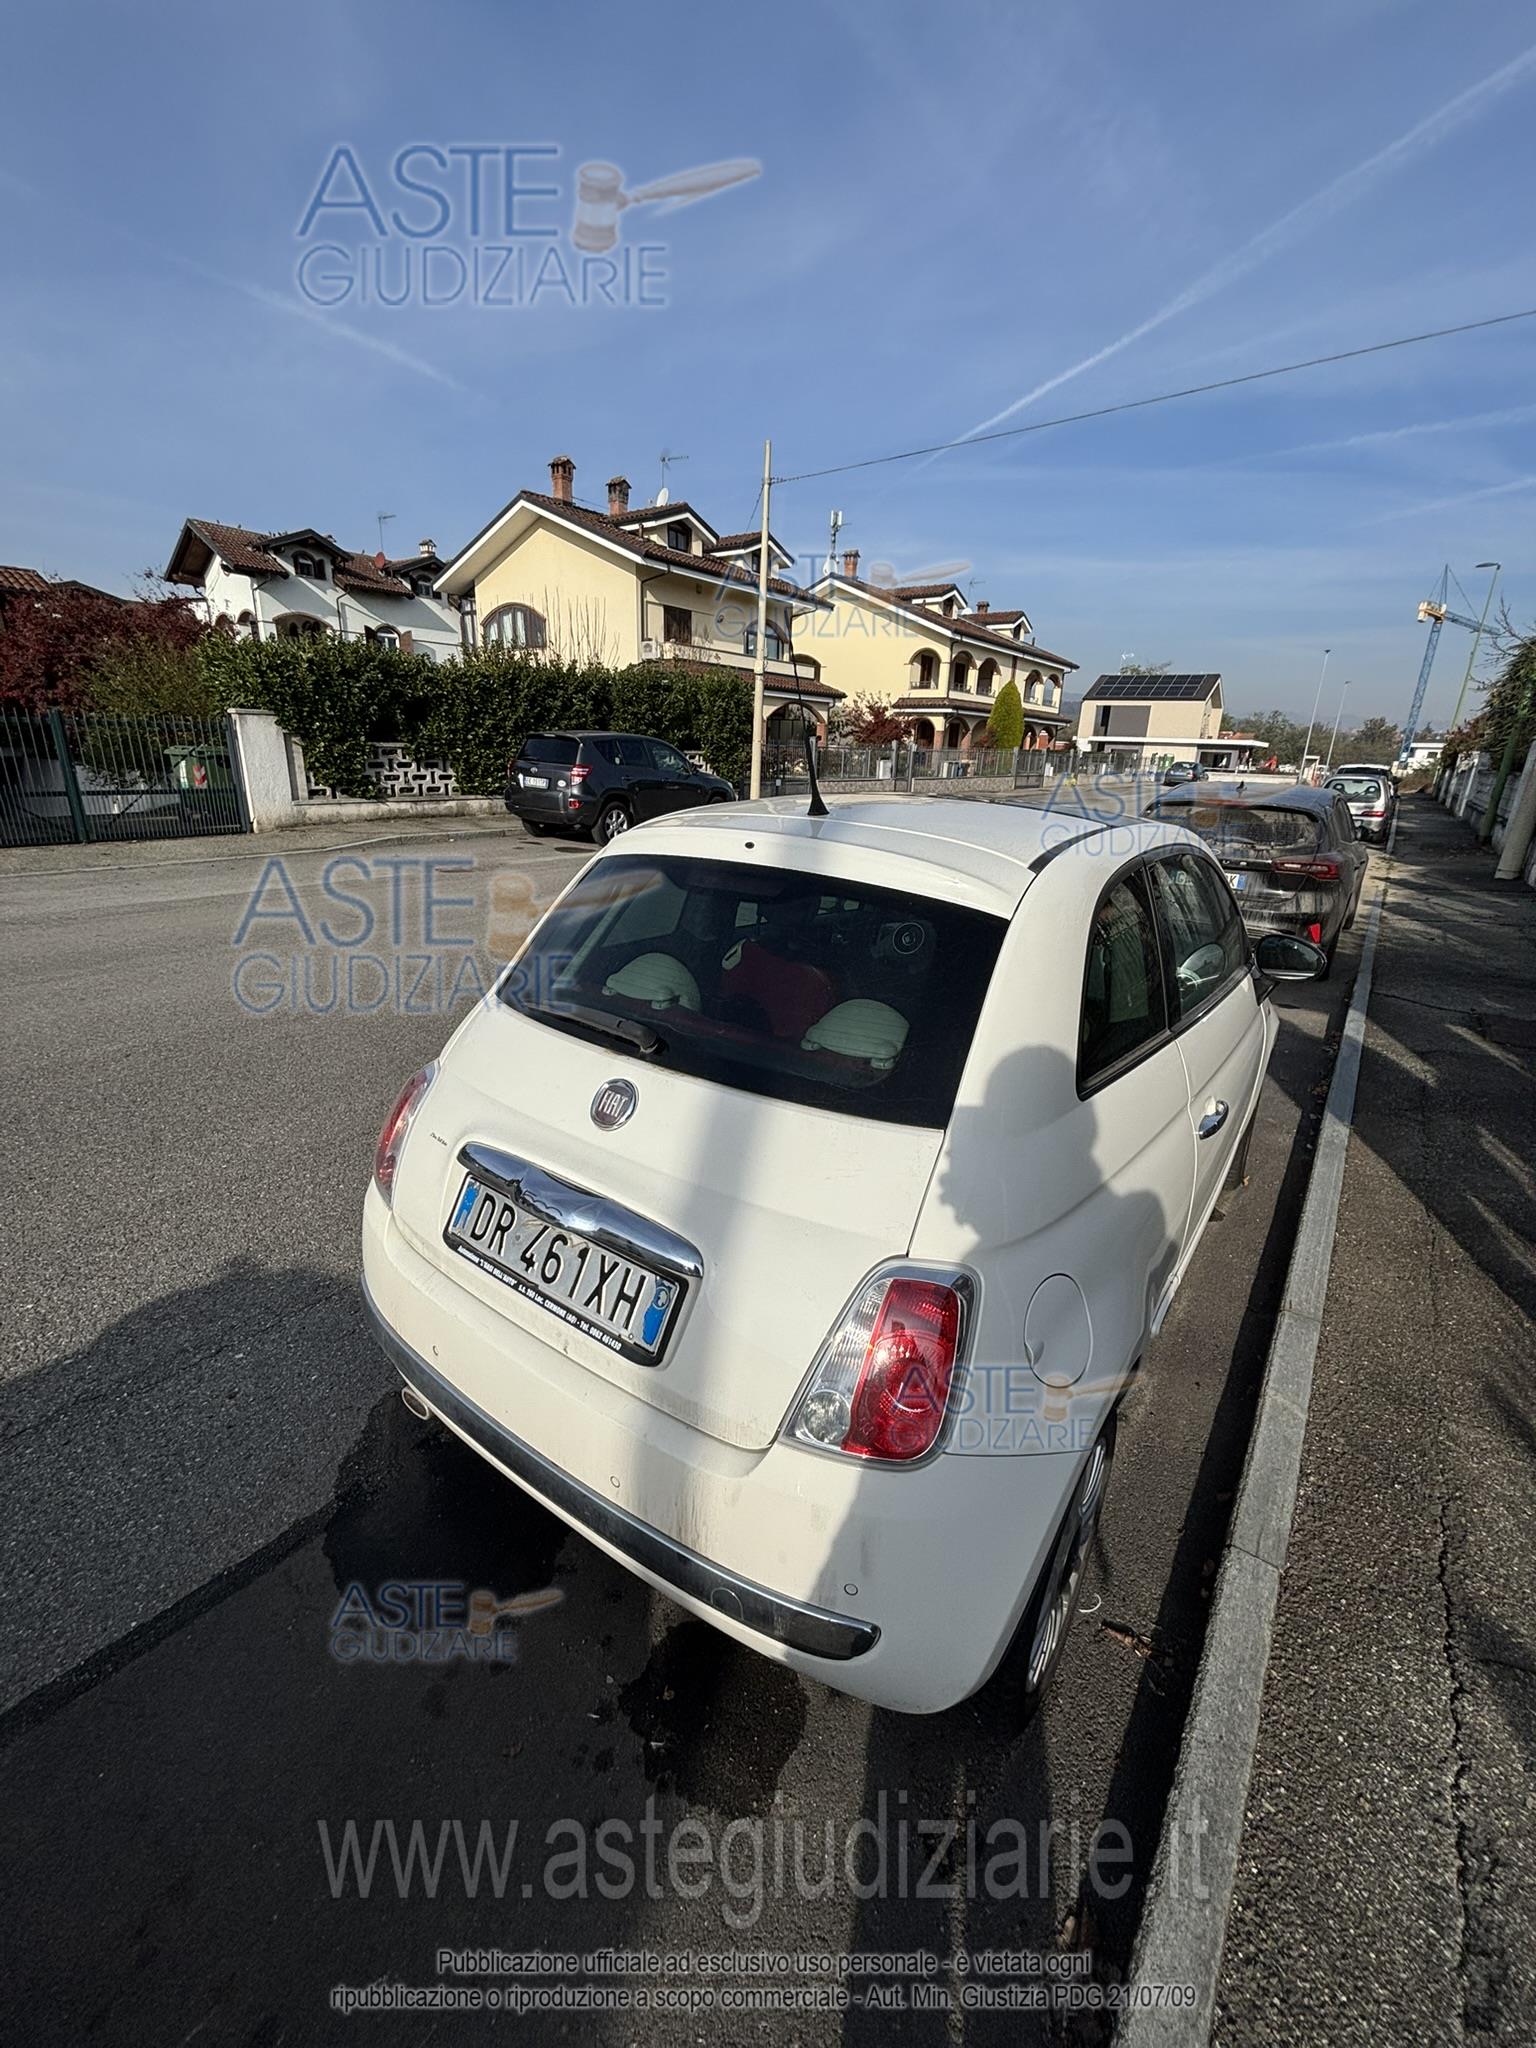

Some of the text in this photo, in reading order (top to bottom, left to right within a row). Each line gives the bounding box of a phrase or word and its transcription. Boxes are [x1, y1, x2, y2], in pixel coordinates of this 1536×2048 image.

[598, 1090, 629, 1117] FIAT
[469, 1192, 648, 1331] DR 461XH
